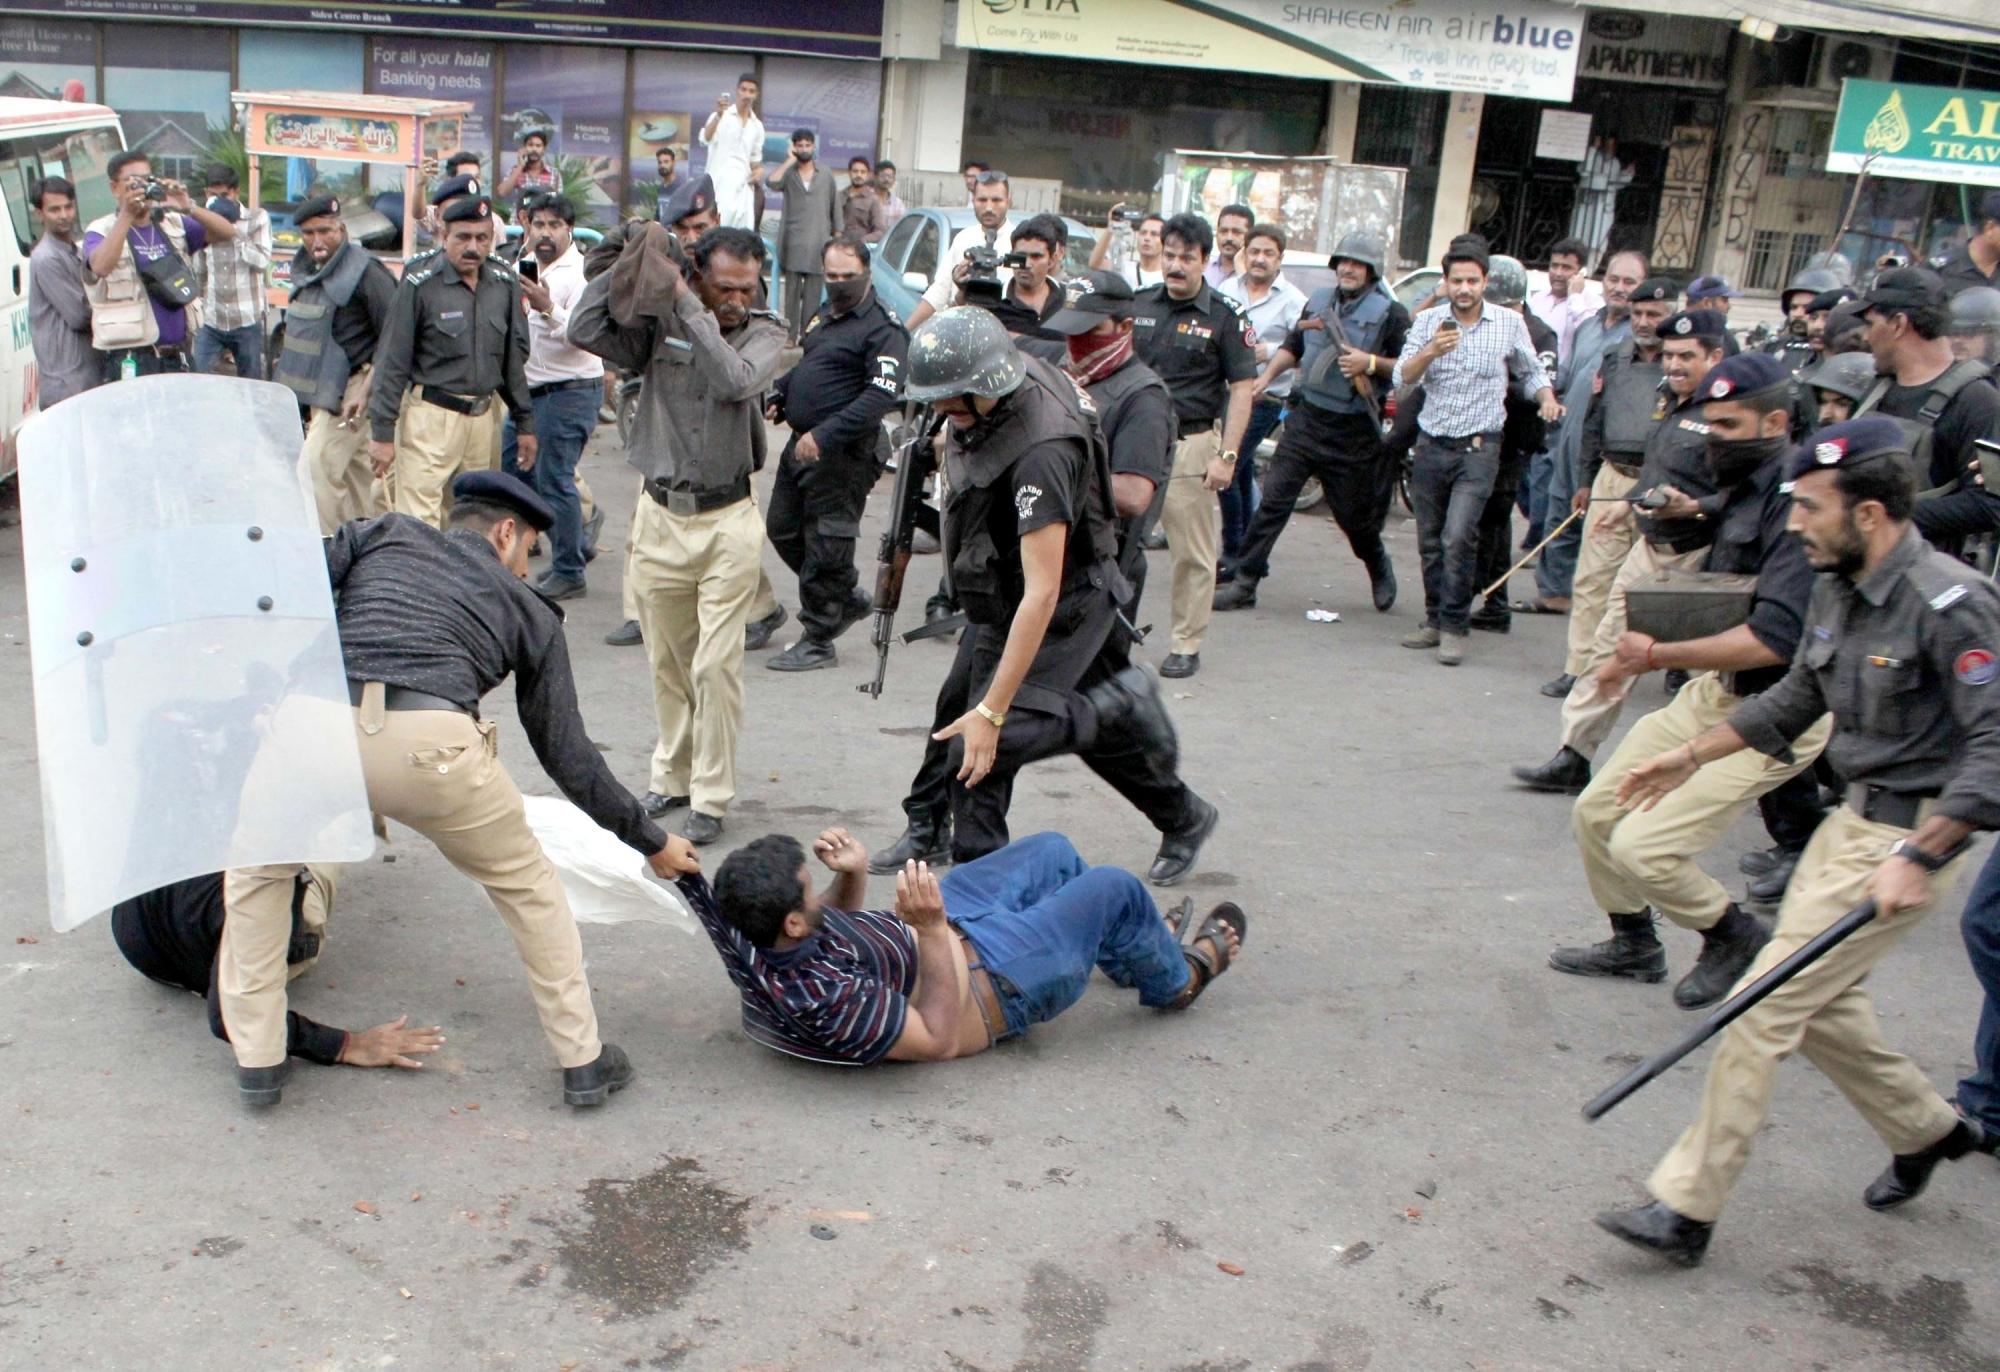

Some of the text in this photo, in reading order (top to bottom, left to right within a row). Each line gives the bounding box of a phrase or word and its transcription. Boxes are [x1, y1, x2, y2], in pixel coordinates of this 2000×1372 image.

[362, 12, 391, 23] Branch
[1281, 4, 1433, 35] SHAHEEN AIR
[987, 25, 1078, 41] Come Fly With Us
[1445, 11, 1574, 50] airblue
[373, 47, 491, 67] For all your halal
[1399, 43, 1449, 65] Travel
[380, 68, 482, 90] Banking needs
[872, 376, 897, 392] POLICE
